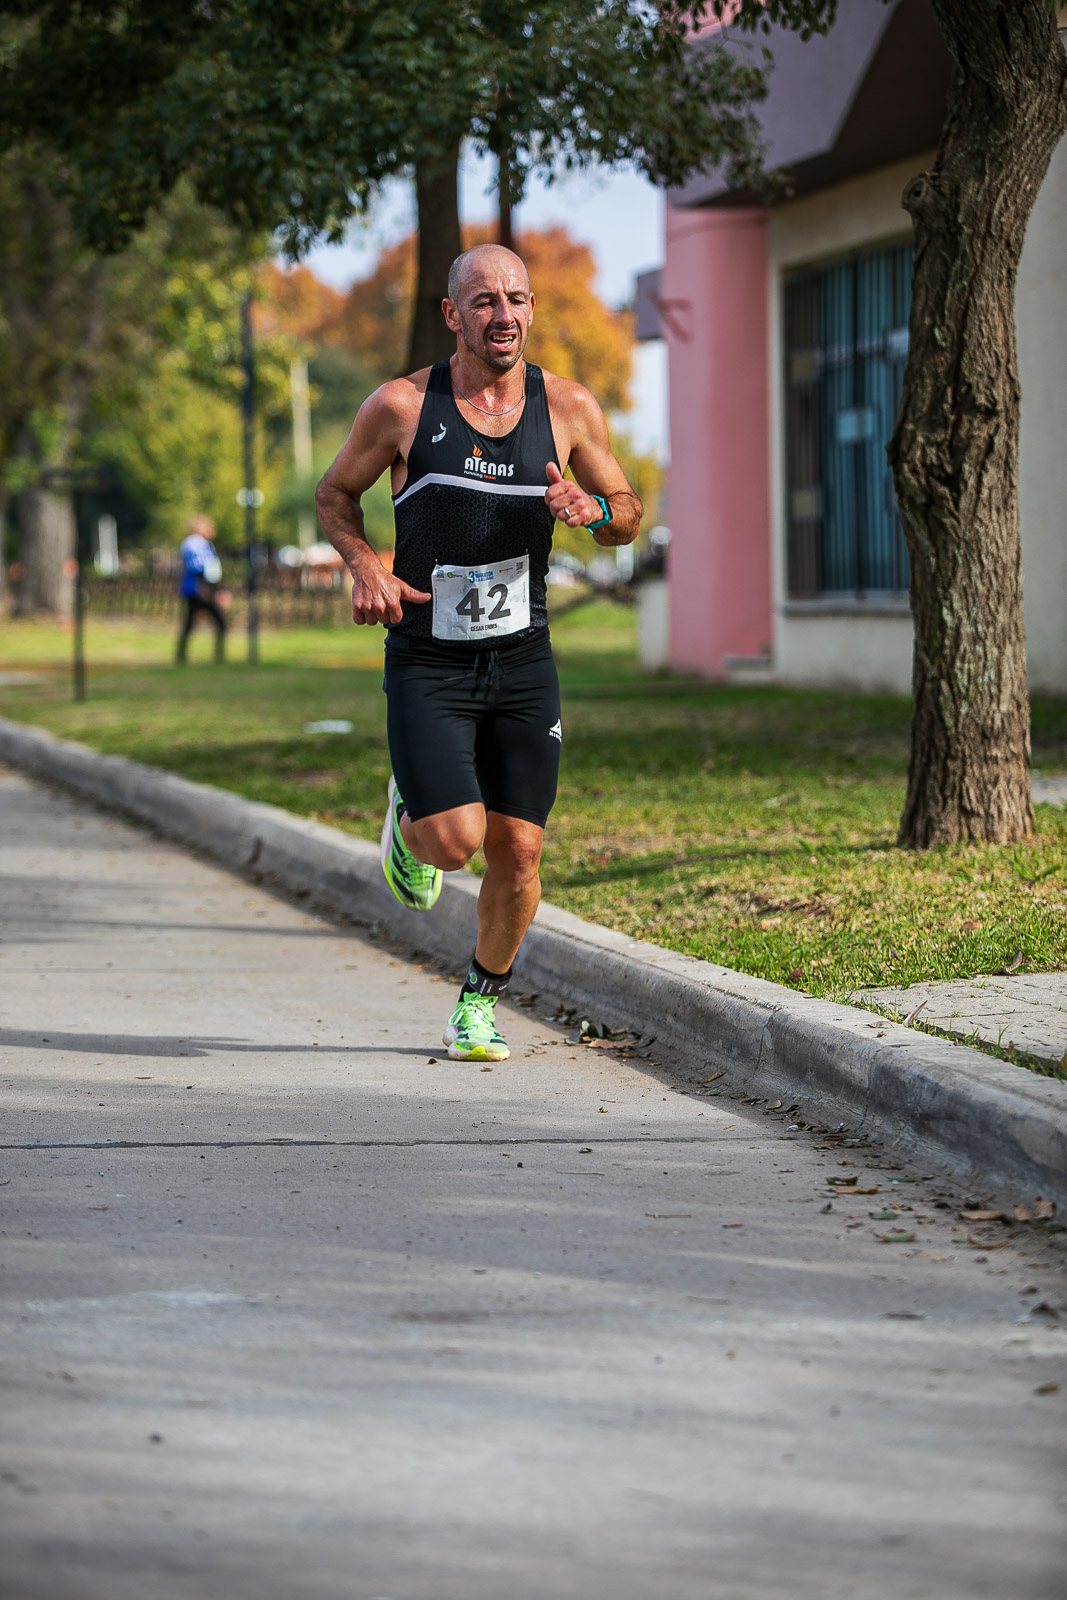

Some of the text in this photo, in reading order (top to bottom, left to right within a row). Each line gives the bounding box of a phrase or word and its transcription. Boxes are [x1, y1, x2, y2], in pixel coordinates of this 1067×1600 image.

[464, 456, 515, 477] ATENAS
[464, 470, 483, 479] running
[455, 583, 511, 622] 42
